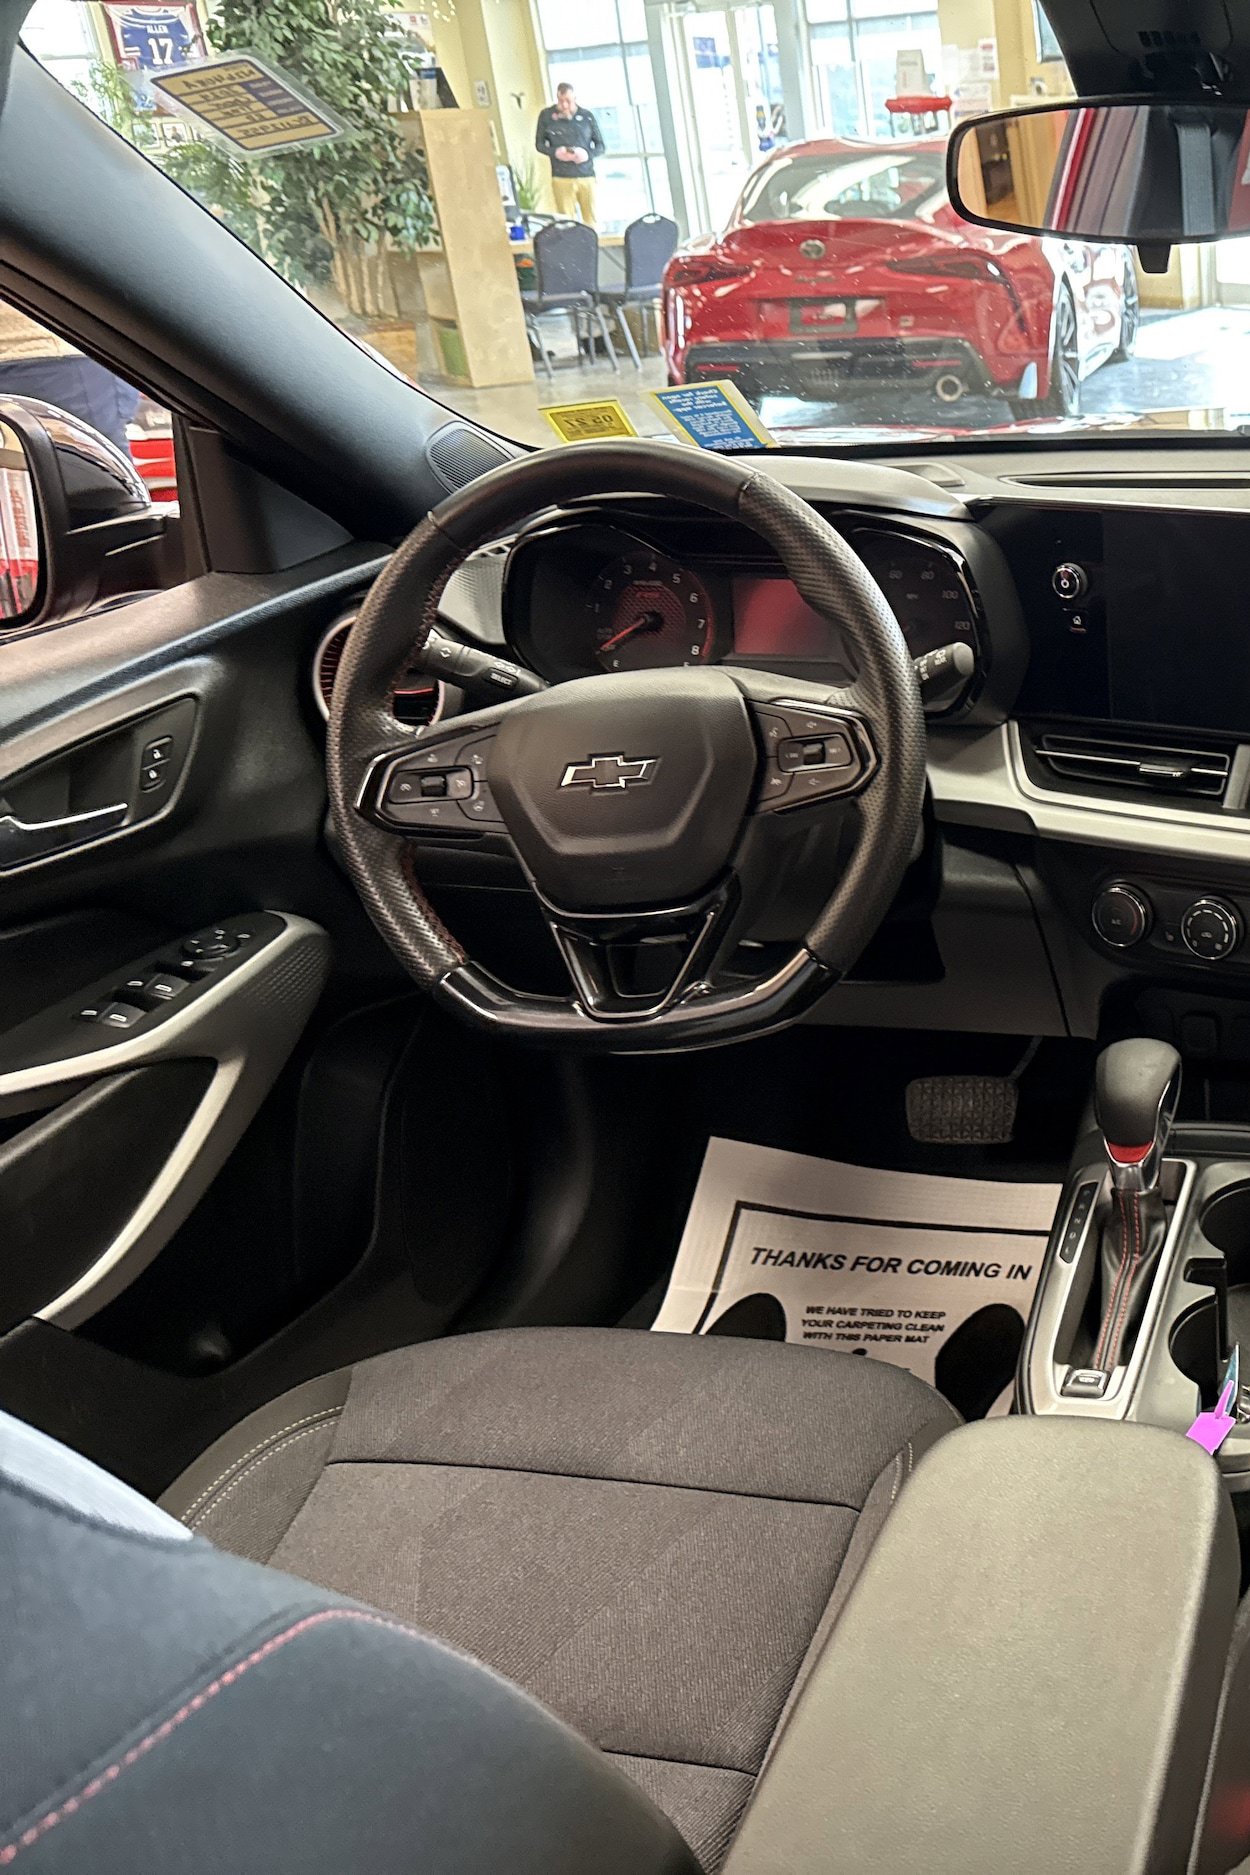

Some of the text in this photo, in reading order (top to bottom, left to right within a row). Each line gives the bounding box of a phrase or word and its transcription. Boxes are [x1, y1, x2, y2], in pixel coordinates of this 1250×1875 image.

[148, 38, 173, 65] 17
[623, 564, 632, 575] 3
[648, 562, 658, 572] 4
[672, 573, 681, 584] 5
[604, 579, 613, 590] 2
[689, 592, 699, 604] 6
[942, 590, 958, 600] 100
[697, 618, 706, 629] 7
[690, 645, 700, 656] 8
[613, 659, 620, 668] E
[490, 672, 512, 686] SELECT
[750, 1247, 1032, 1281] THANKS FOR COMING IN
[805, 1305, 946, 1319] WE HAVE TRIED TO KEEP
[801, 1319, 945, 1332] YOUR CARPETING CLEAN
[803, 1331, 930, 1343] WITH THIS PAPER MAT
